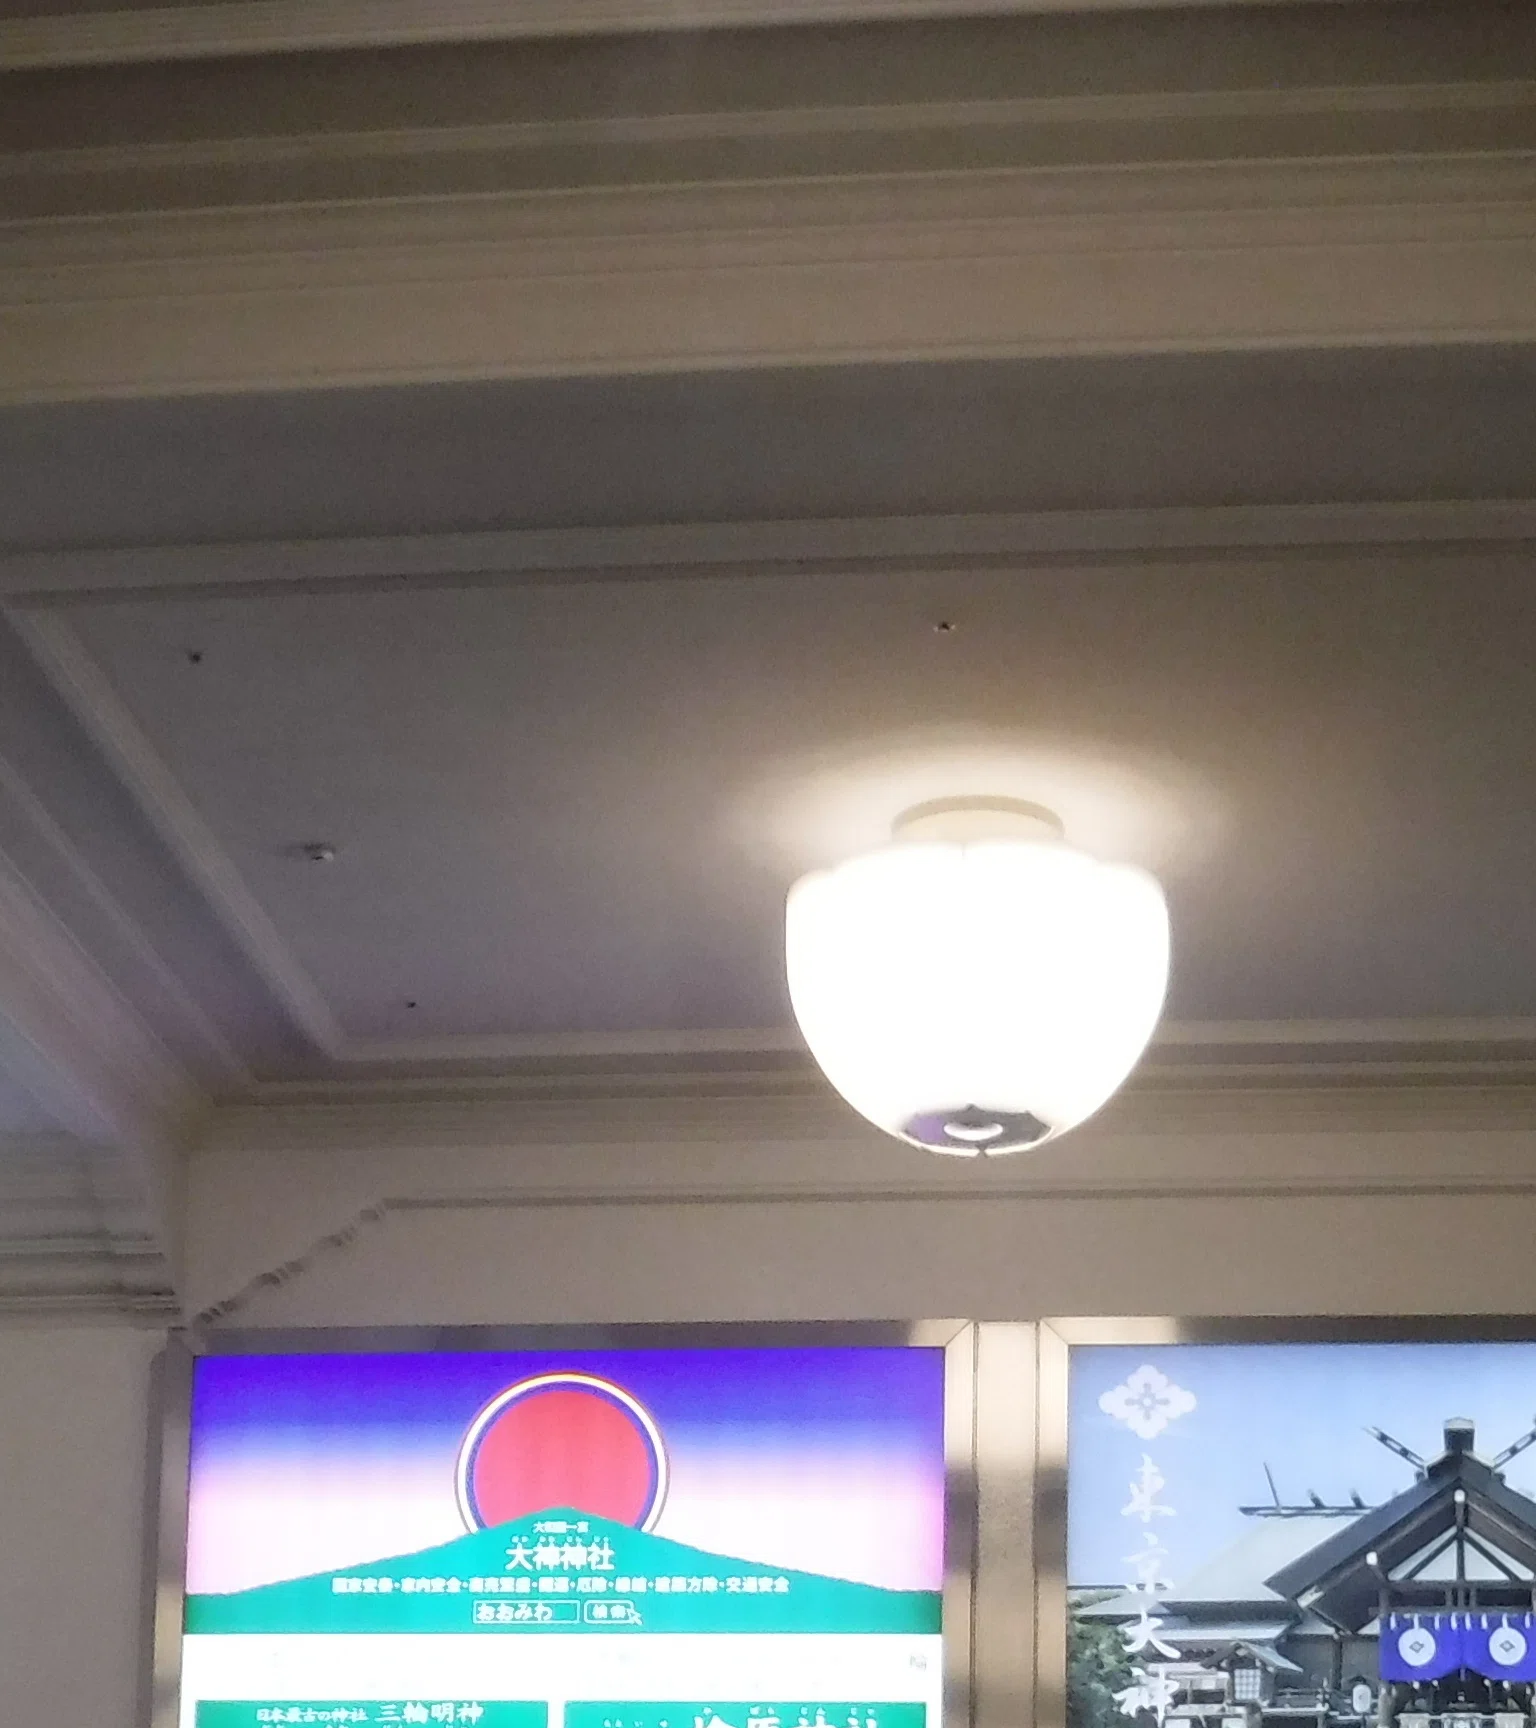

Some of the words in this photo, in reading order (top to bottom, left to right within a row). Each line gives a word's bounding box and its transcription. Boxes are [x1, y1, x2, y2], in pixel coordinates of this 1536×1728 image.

[505, 1541, 615, 1571] 大神神社
[477, 1601, 552, 1620] おおみわ
[374, 1701, 485, 1725] 三輪明神
